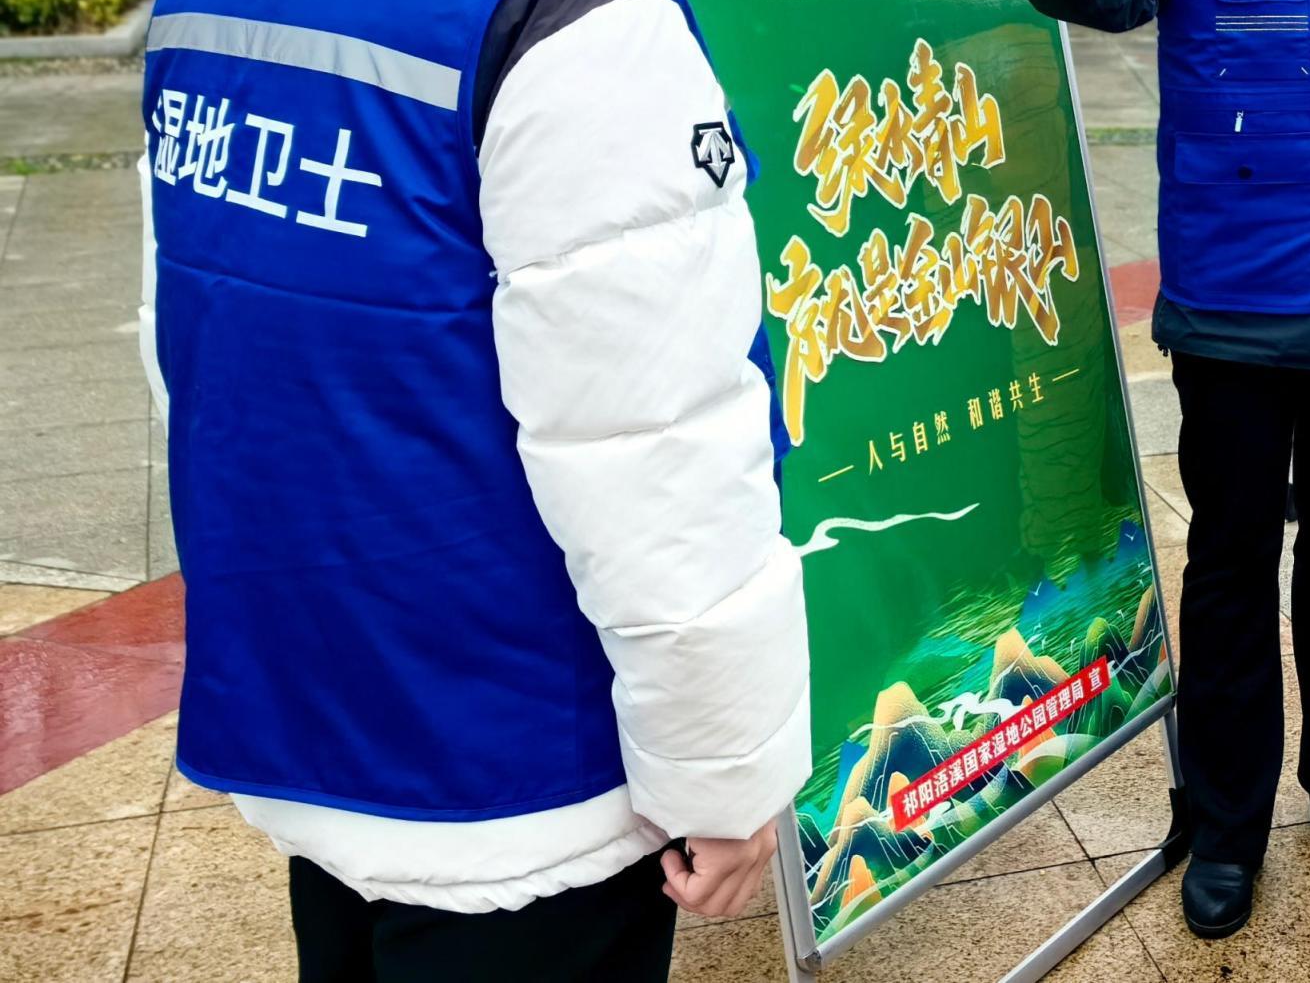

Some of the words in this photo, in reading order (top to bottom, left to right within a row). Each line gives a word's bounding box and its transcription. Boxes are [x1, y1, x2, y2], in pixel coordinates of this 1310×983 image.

[151, 88, 383, 239] 湿地卫士
[792, 38, 1006, 236] 绿水青山
[766, 194, 1079, 446] 就是金山银山
[868, 410, 951, 476] 人与自然
[967, 372, 1044, 431] 和谐共生
[902, 678, 1085, 818] 祁阳浯溪国家湿地公园管理局
[1088, 667, 1103, 693] 宣
